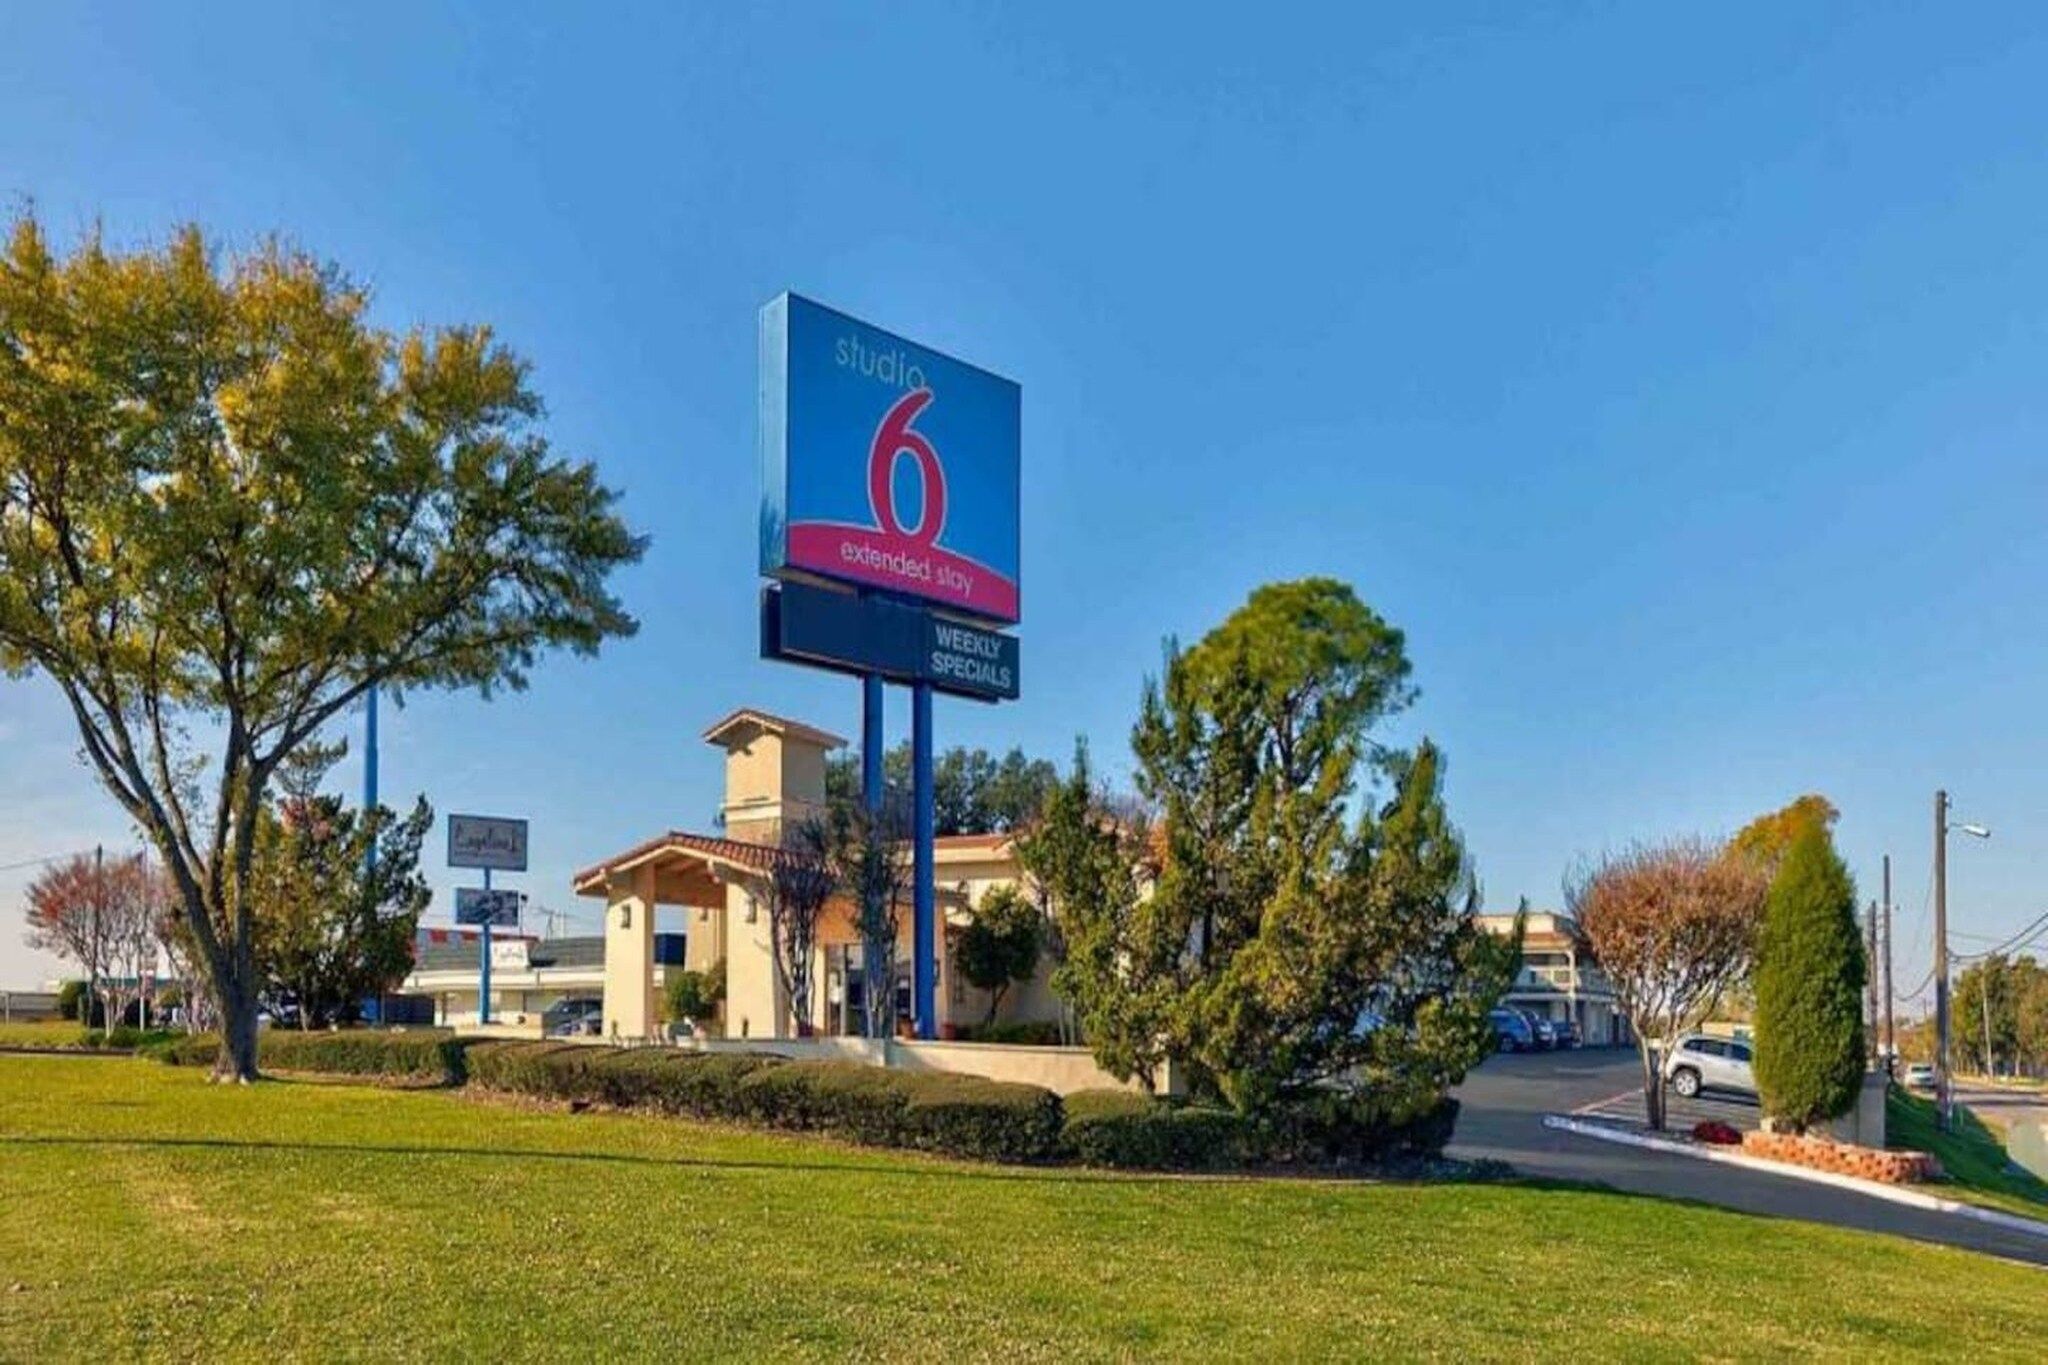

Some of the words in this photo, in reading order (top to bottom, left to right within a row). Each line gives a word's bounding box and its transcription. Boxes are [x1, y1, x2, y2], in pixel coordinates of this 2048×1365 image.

[835, 335, 925, 391] studio
[867, 387, 948, 546] 6
[839, 541, 931, 580] extended
[937, 565, 973, 599] stay
[935, 624, 1002, 659] WEEKLY
[931, 651, 1011, 689] SPECIALS
